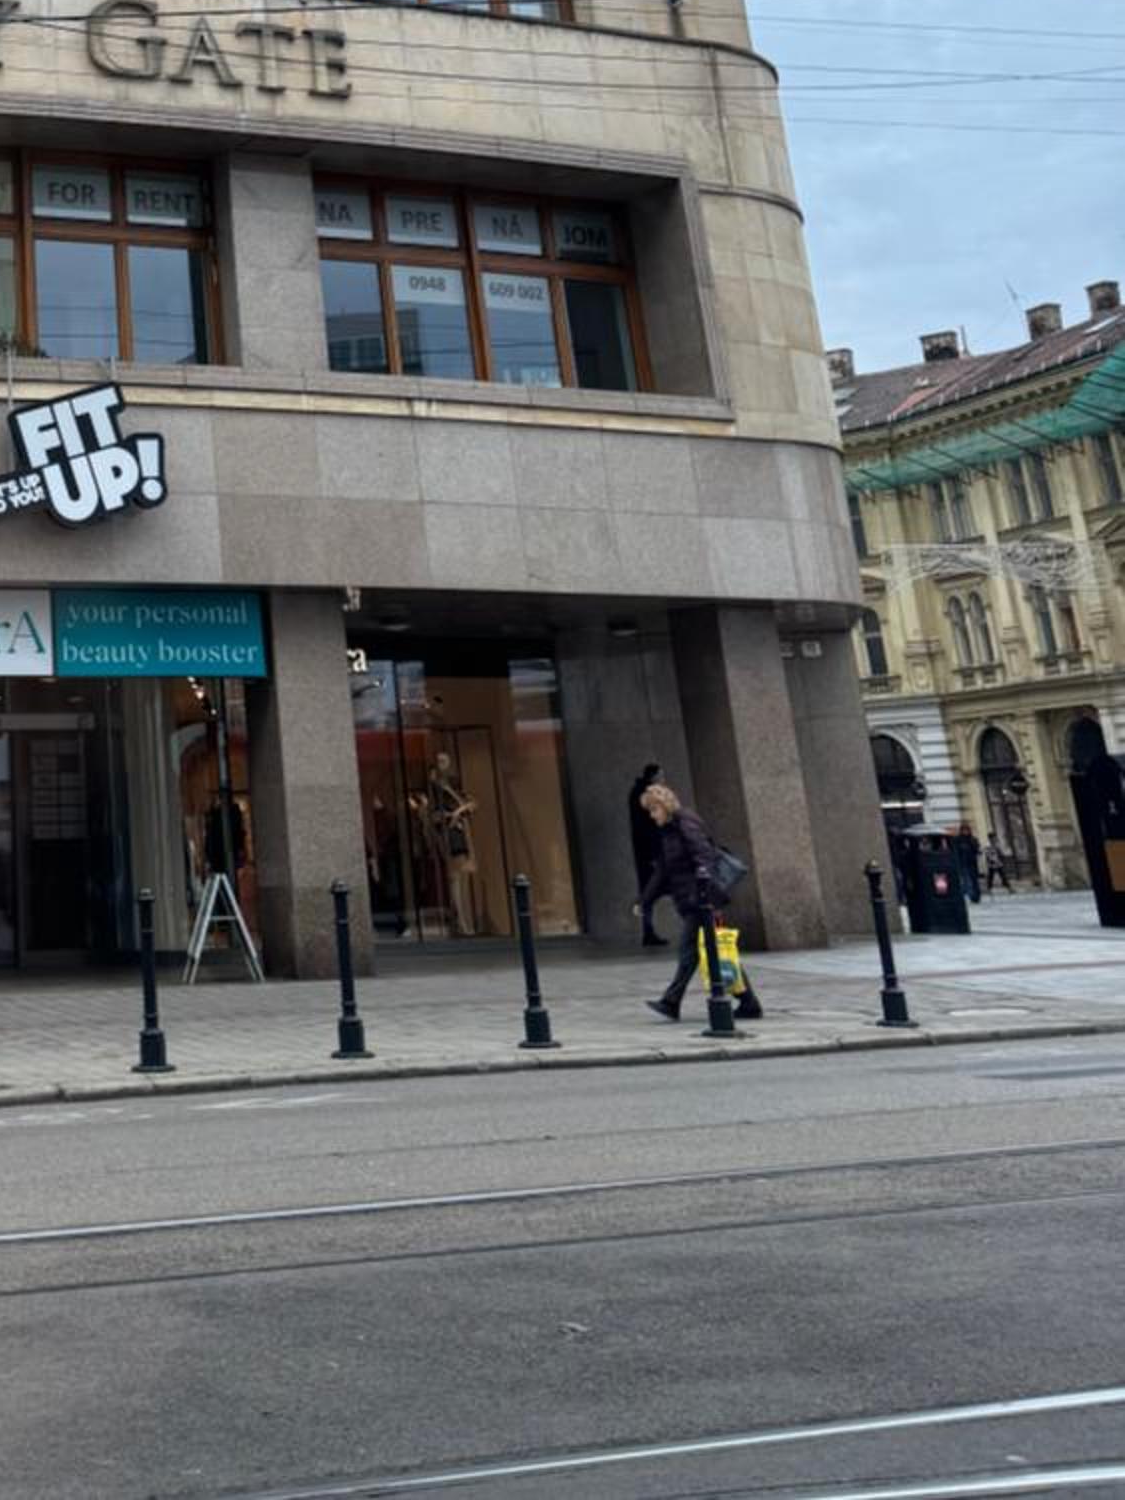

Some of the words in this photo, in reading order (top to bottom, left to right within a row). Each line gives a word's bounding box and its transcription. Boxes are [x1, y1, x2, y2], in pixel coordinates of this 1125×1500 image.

[47, 181, 95, 205] FOR
[133, 189, 196, 213] RENT
[319, 201, 353, 223] NA
[401, 208, 443, 232] PRE
[563, 224, 607, 247] JOM
[408, 274, 446, 292] 0948
[15, 386, 120, 470] FIT
[18, 473, 40, 490] UP
[42, 438, 164, 522] UP!
[65, 602, 126, 629] your
[135, 599, 249, 632] personal
[62, 638, 150, 668] beauty
[158, 637, 259, 665] booster
